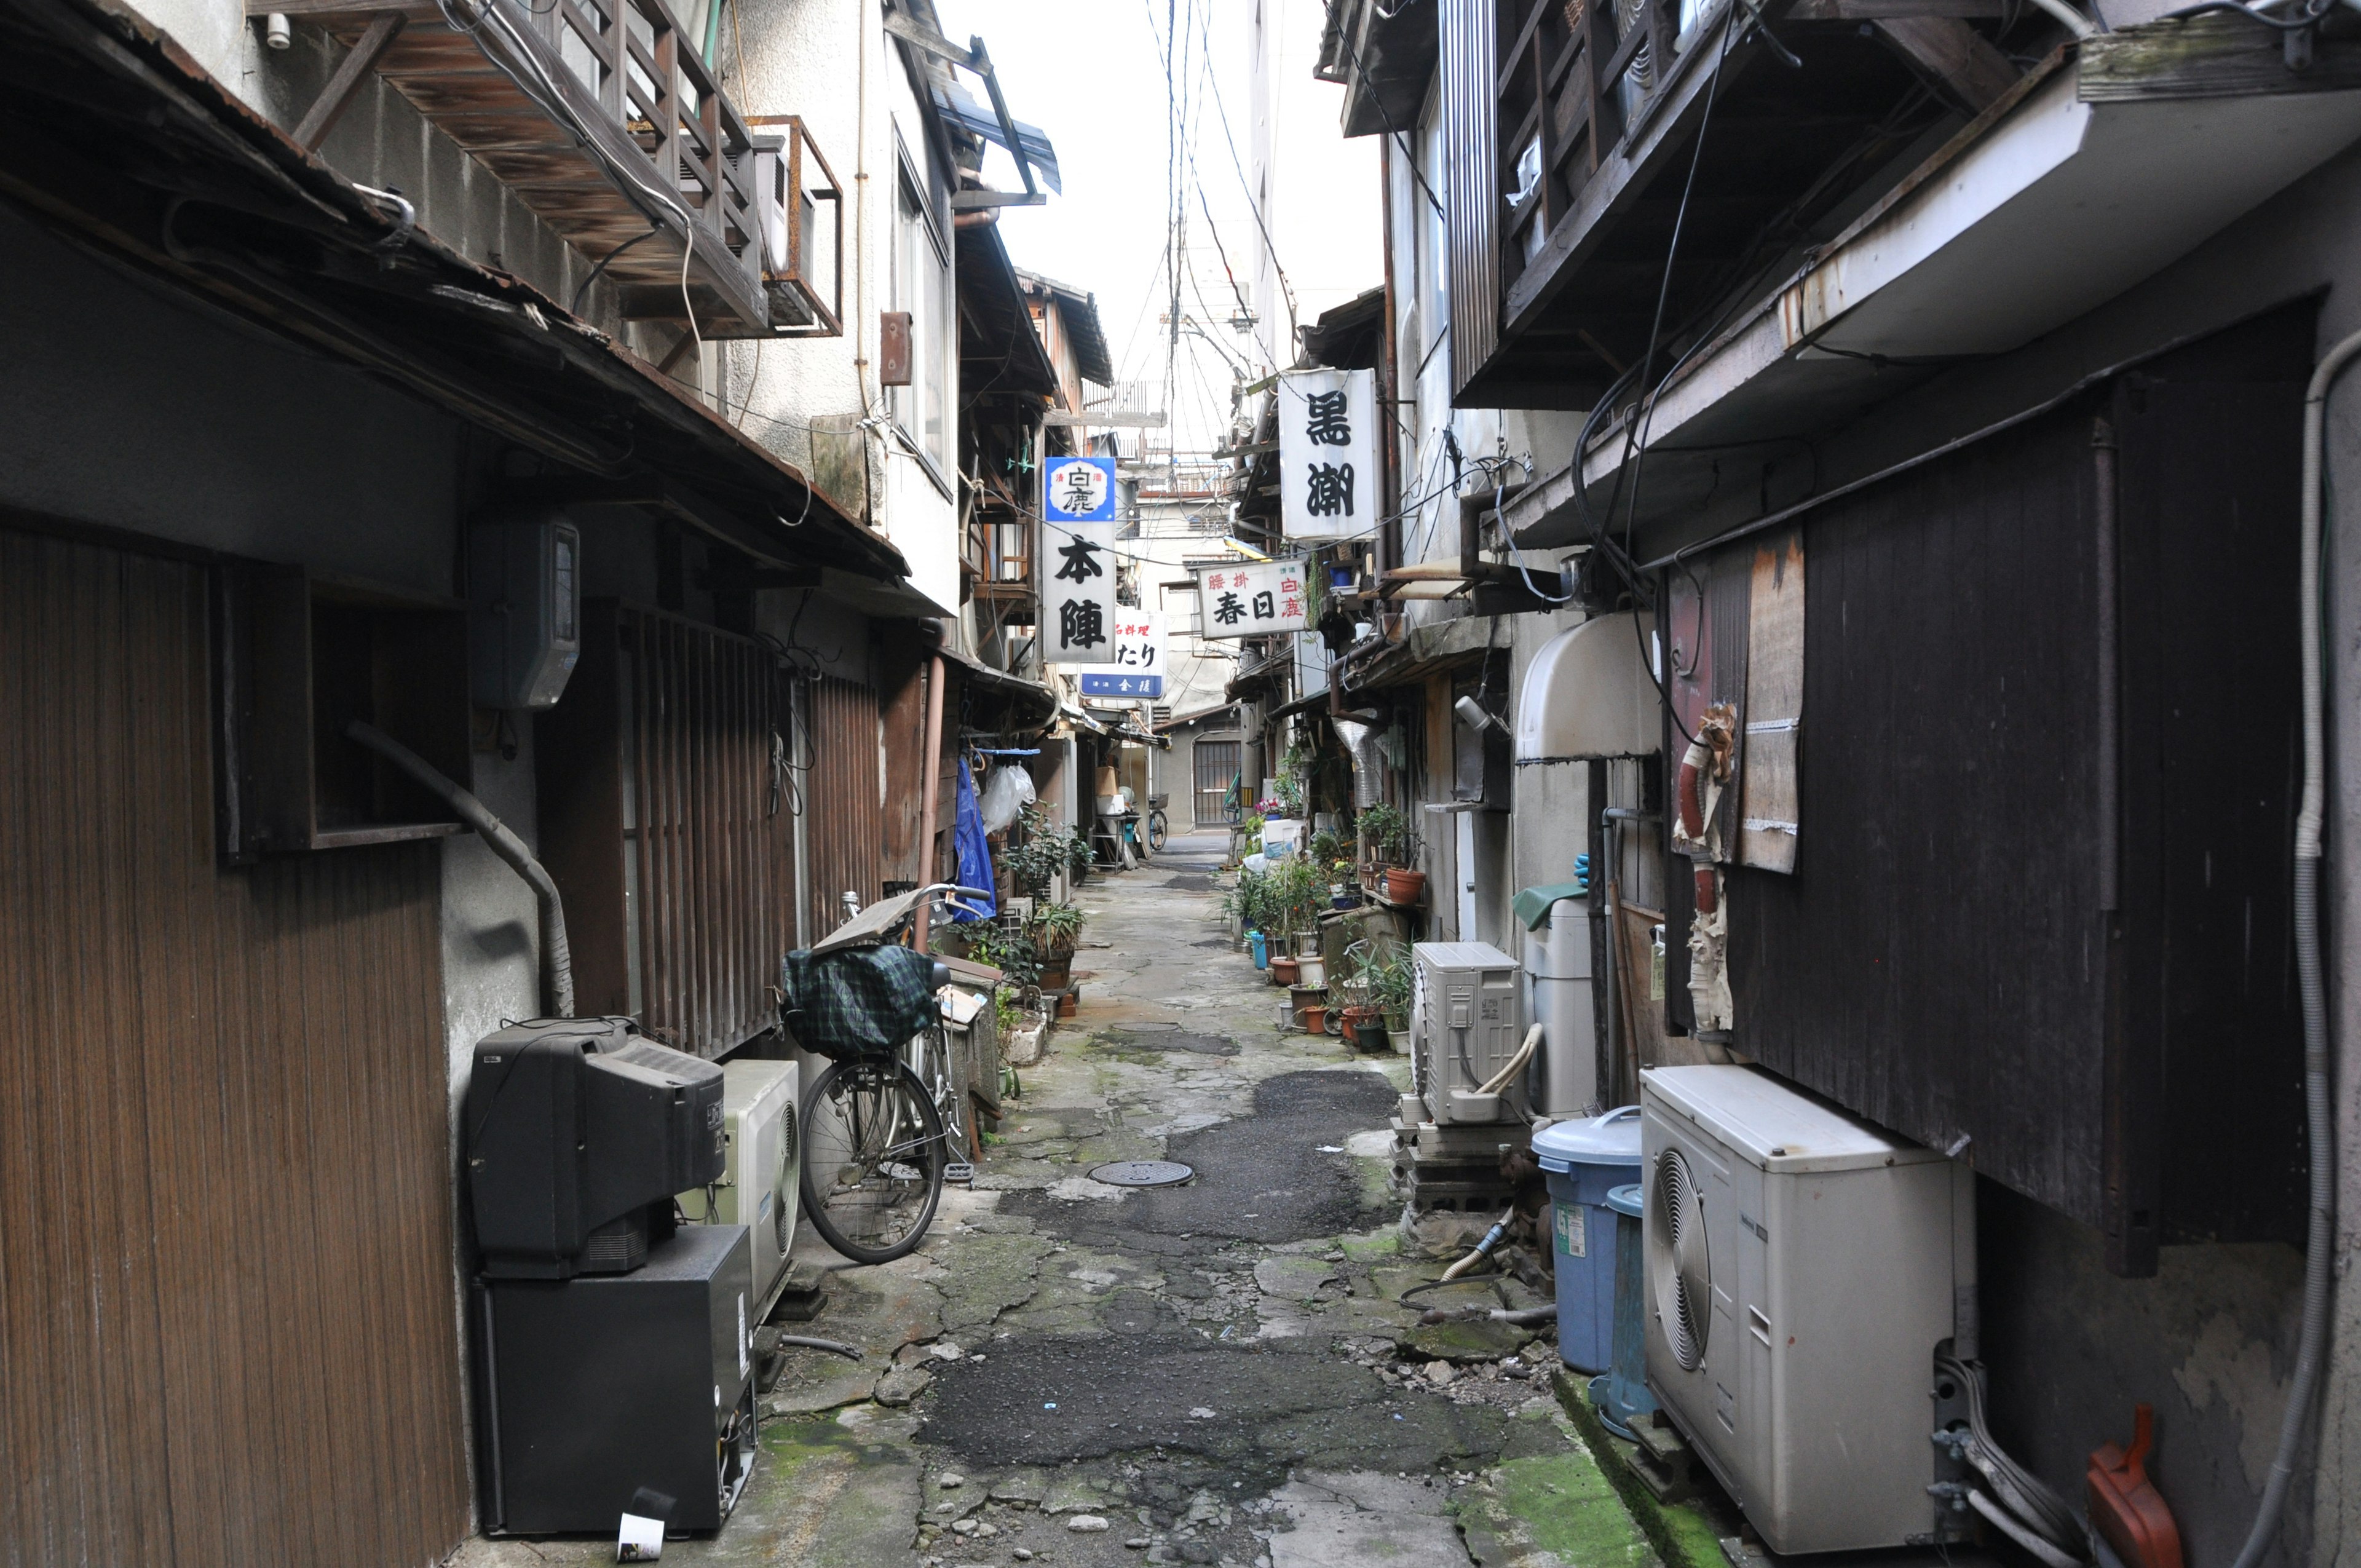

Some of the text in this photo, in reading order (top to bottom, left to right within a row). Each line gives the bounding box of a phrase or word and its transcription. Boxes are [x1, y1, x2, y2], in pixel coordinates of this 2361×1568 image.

[1306, 390, 1355, 517] 黒潮
[1062, 466, 1095, 512] 白鹿
[1054, 534, 1106, 650] 本陣
[1213, 590, 1275, 625] 春日
[1280, 577, 1303, 617] 白鹿
[1117, 643, 1155, 668] たり
